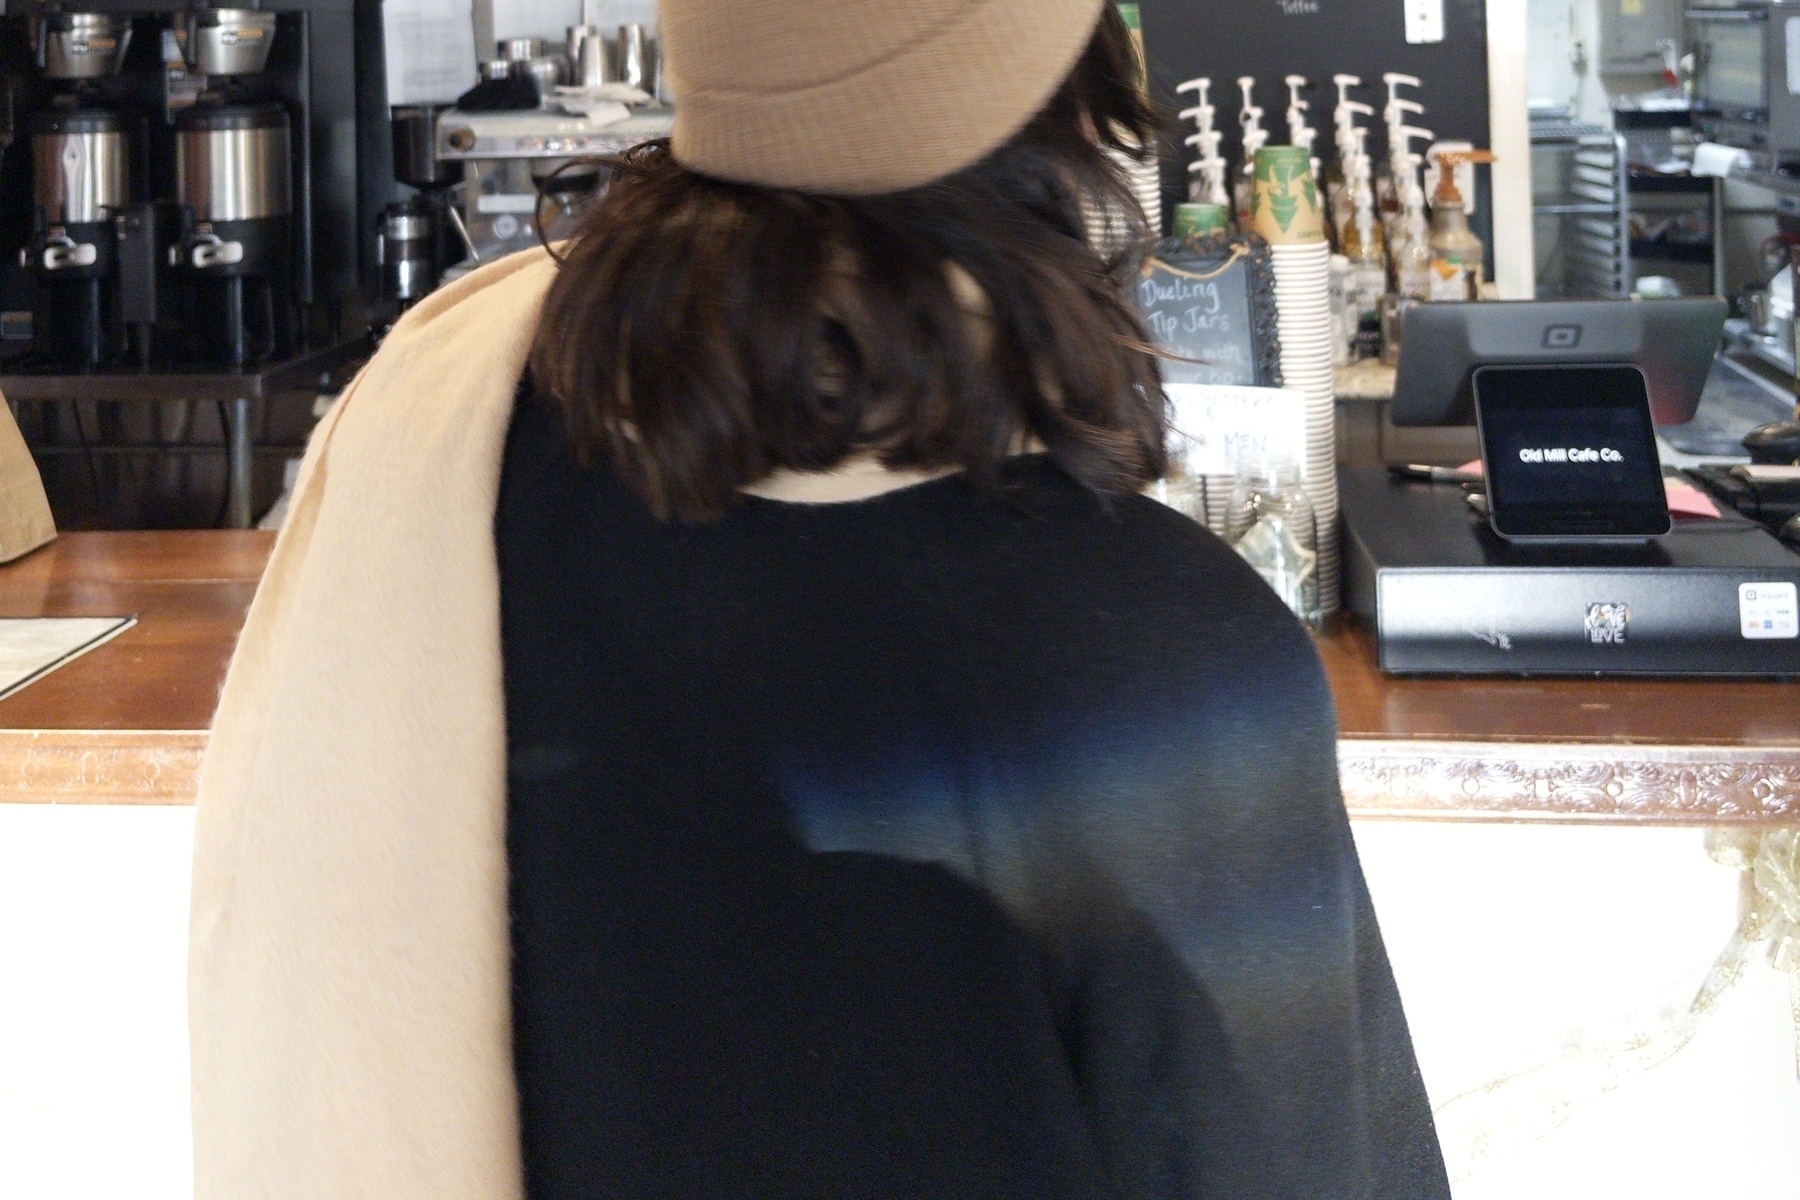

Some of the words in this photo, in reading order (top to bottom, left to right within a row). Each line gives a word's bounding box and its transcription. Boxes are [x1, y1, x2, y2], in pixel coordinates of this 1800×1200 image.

[1141, 276, 1221, 314] Dueling
[1148, 310, 1178, 343] Tip
[1183, 306, 1230, 333] Jars
[1519, 446, 1543, 464] Old
[1544, 445, 1568, 463] Mill
[1568, 446, 1600, 464] Cafe
[1600, 447, 1625, 464] Co.
